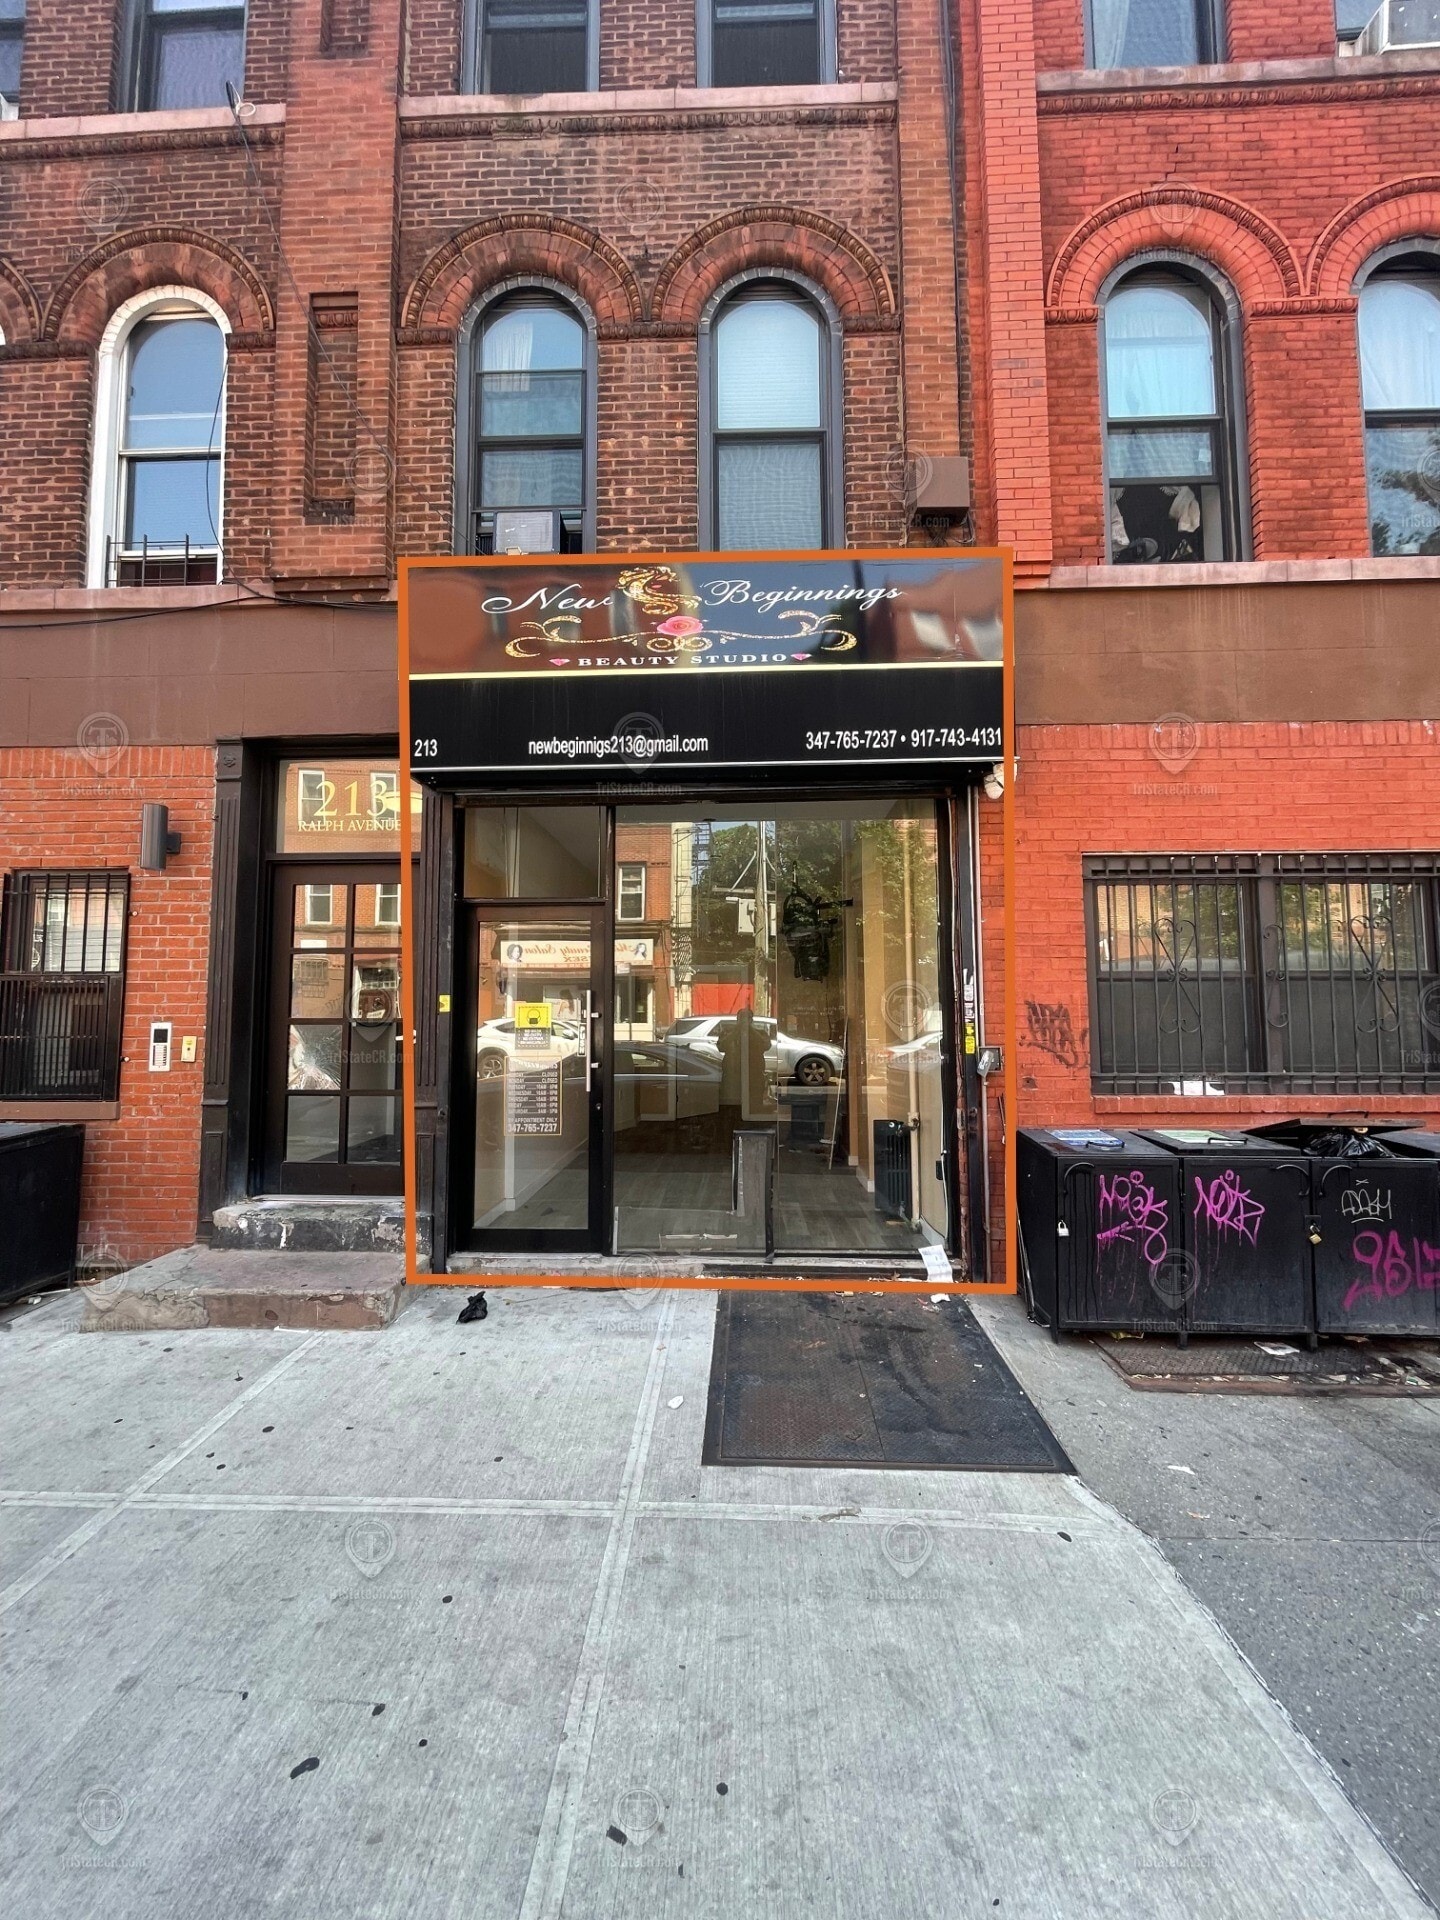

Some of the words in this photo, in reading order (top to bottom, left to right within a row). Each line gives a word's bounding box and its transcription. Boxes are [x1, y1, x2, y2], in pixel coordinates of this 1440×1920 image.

[481, 583, 614, 613] New
[701, 579, 903, 613] Beginnings
[578, 655, 679, 667] BEAUTY
[690, 653, 787, 665] STUDIO
[414, 739, 438, 757] 213
[528, 735, 709, 758] newbeginnigs213@gmail.com
[806, 730, 898, 750] 347-765-7237
[911, 727, 1002, 747] 917-743-4131
[314, 779, 388, 817] 213
[298, 819, 343, 832] RALPH
[348, 819, 402, 832] AVENUE
[507, 1123, 558, 1133] 347-765-7237
